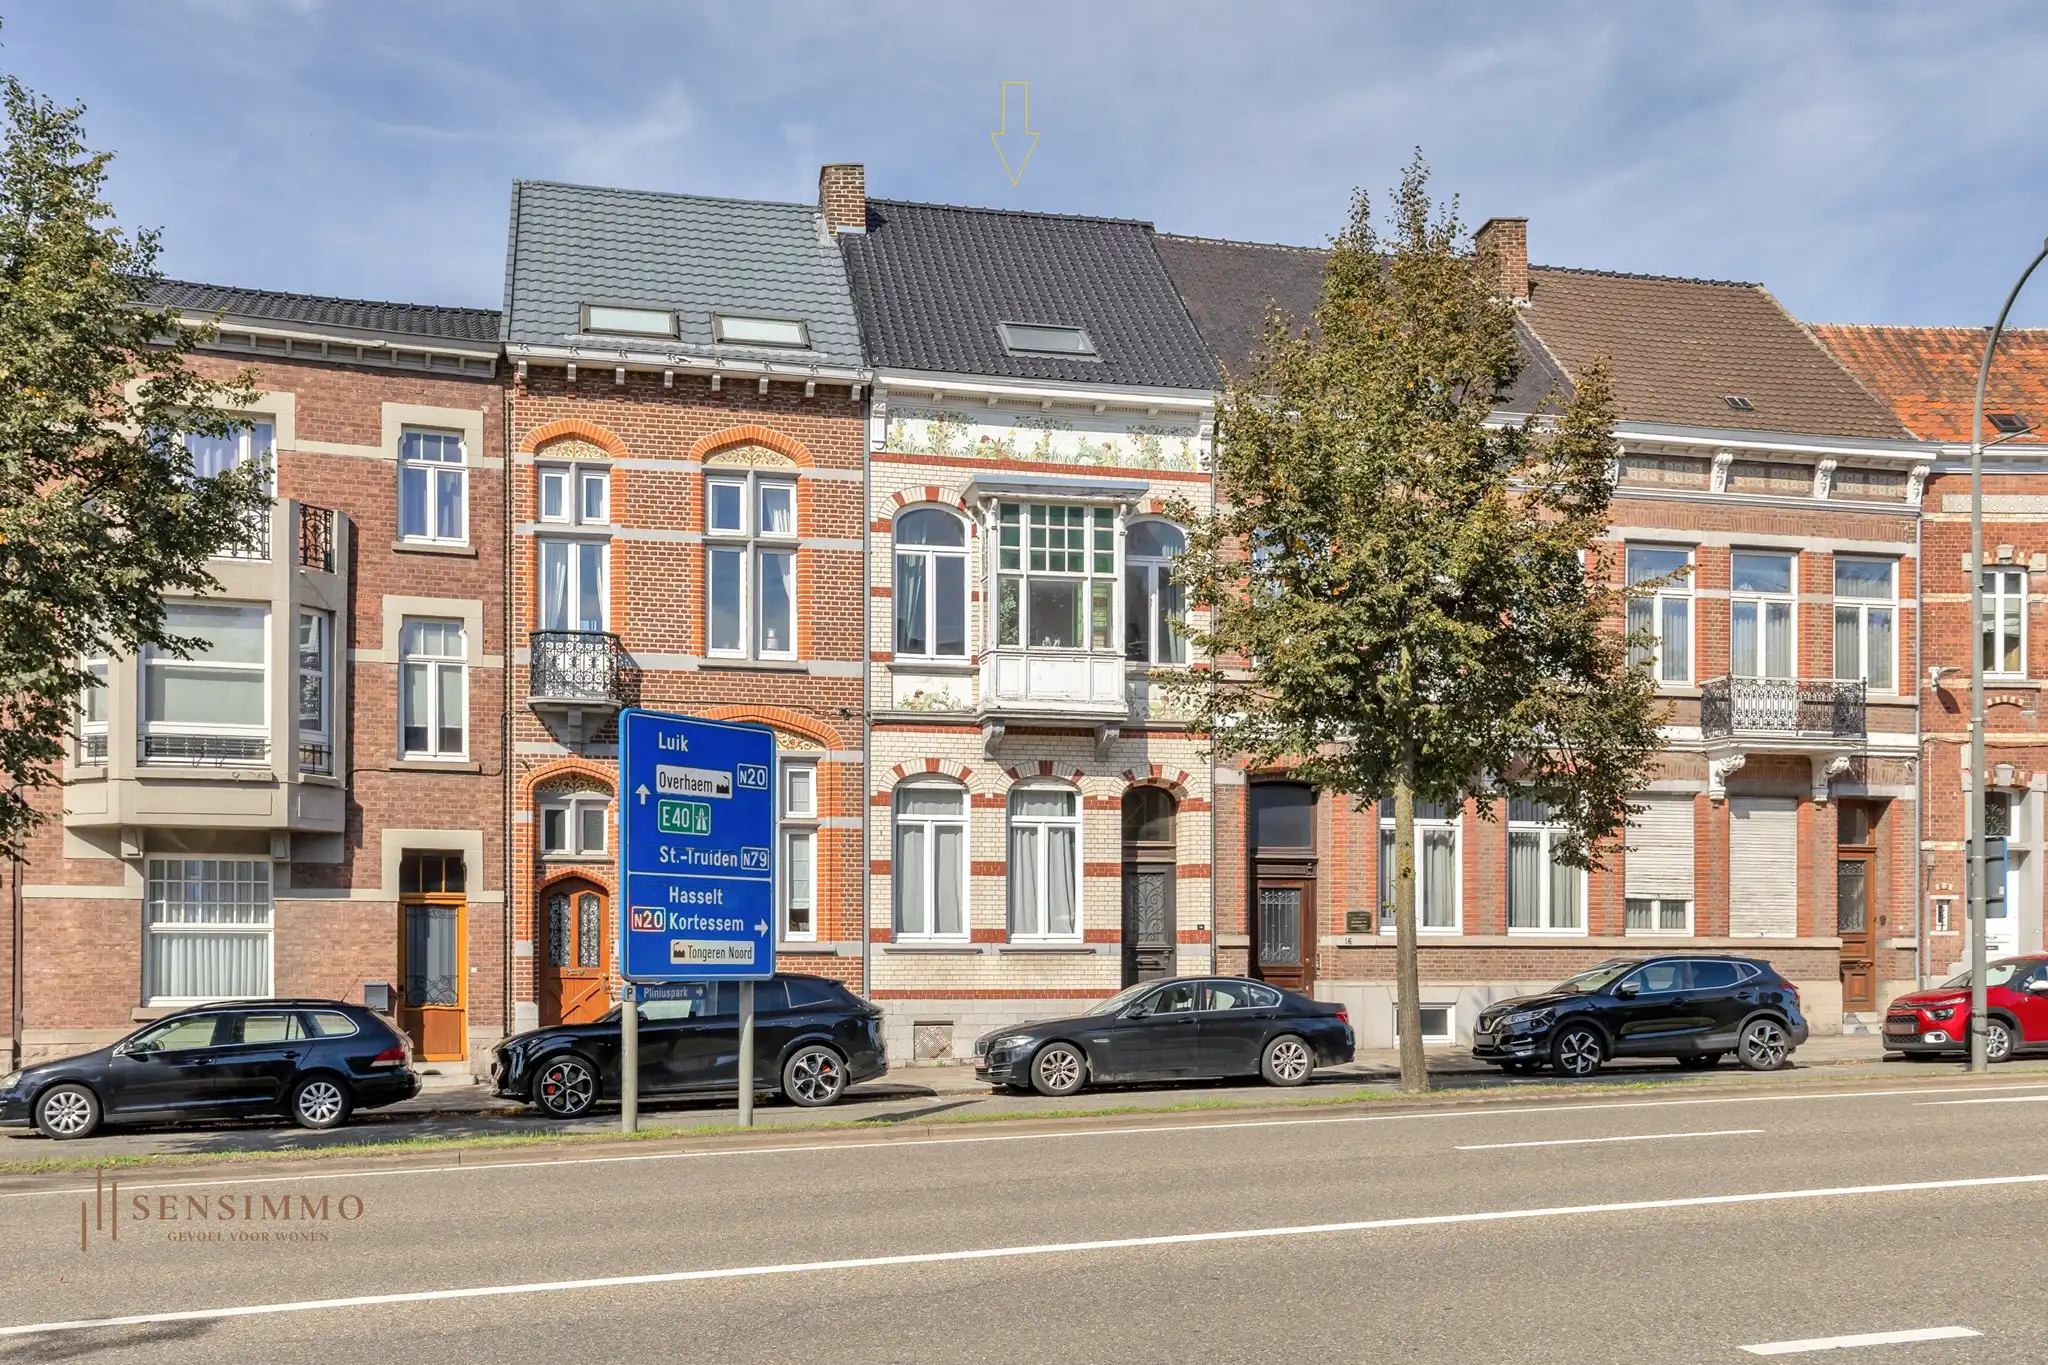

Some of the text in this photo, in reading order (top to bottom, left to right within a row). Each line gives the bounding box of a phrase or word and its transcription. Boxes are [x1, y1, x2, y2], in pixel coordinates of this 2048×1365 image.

[658, 731, 689, 752] Luik
[659, 771, 713, 793] Overhaem
[739, 768, 766, 786] N20
[662, 806, 690, 828] E40
[659, 845, 738, 867] St.-Truiden
[743, 851, 767, 868] N79
[669, 886, 723, 905] Hasselt
[634, 910, 663, 929] N20
[669, 912, 744, 931] Kortessem
[688, 945, 753, 962] Tongeren Noord
[626, 987, 688, 1000] P Pliniuspark
